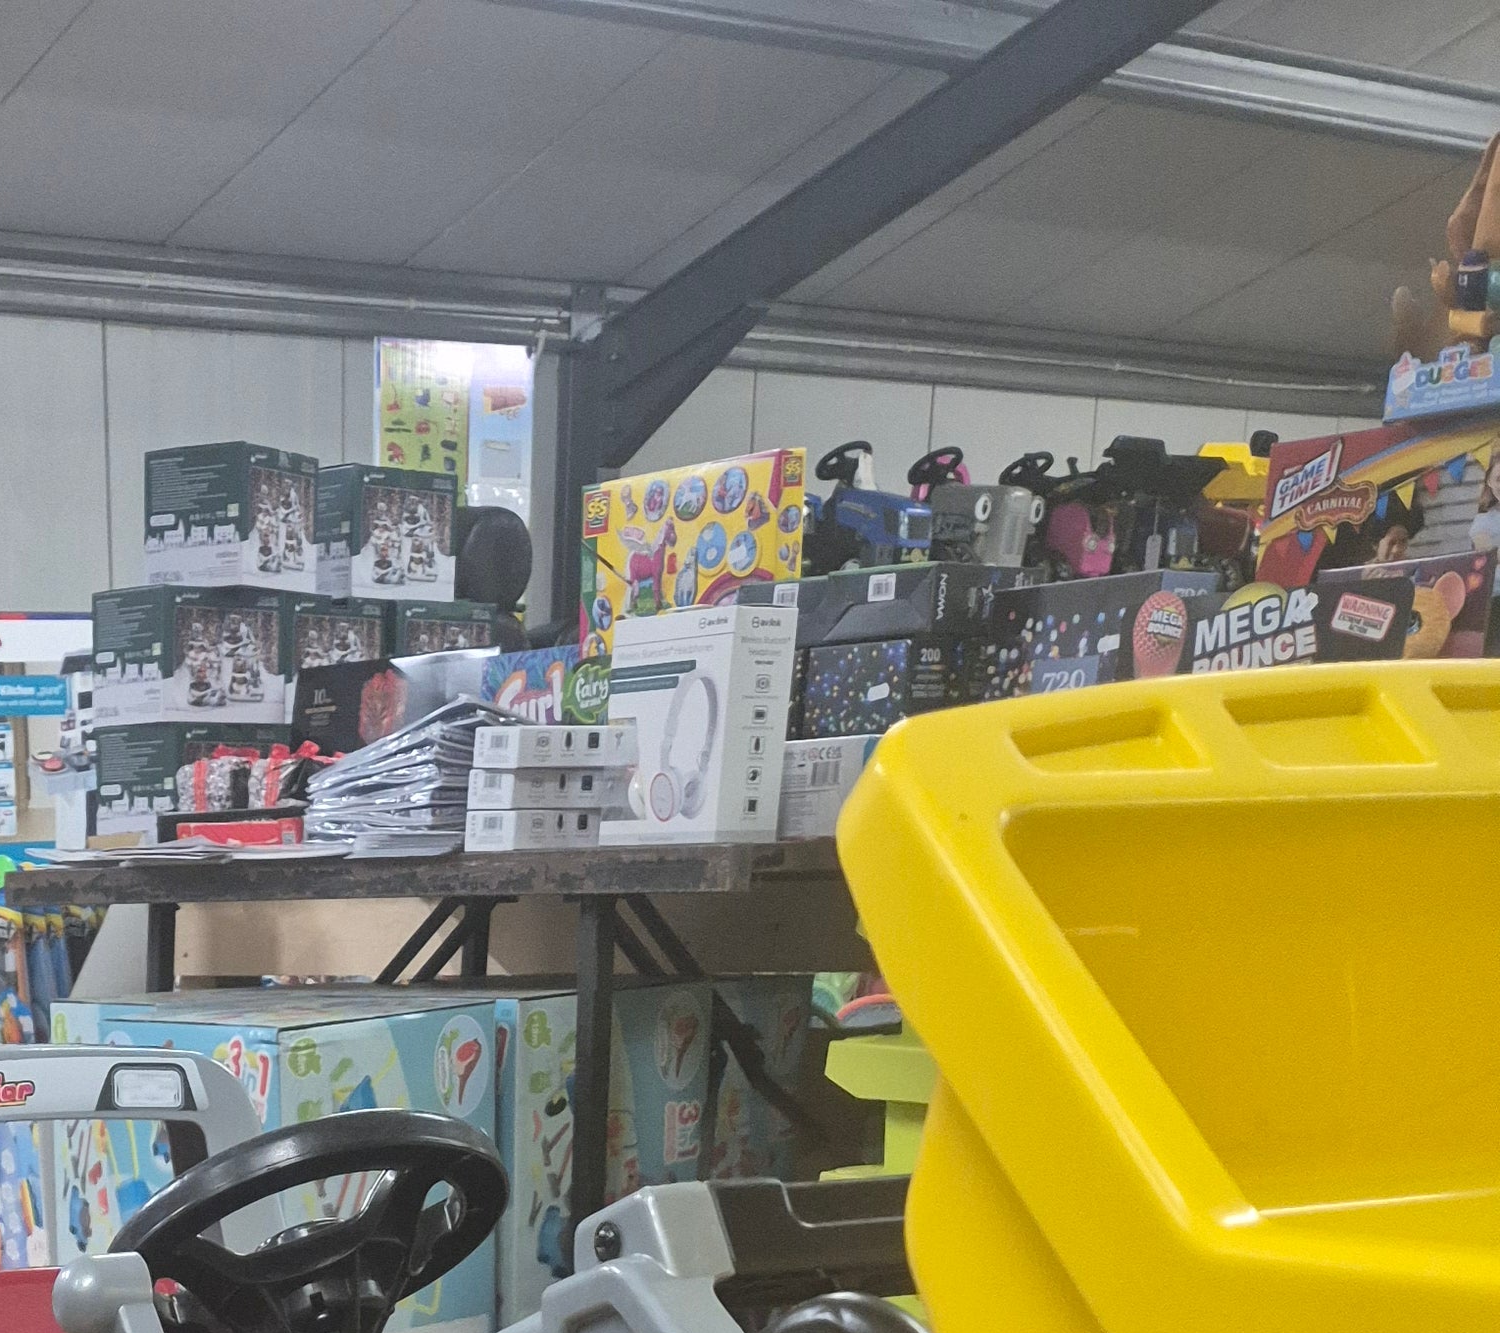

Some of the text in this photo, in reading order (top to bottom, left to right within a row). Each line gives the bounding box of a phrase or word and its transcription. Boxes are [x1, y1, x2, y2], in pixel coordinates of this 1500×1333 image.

[1279, 457, 1327, 495] GAME
[1307, 497, 1363, 515] CARNIVAL
[936, 573, 948, 620] NOMA
[1150, 609, 1183, 628] MEGA
[1194, 588, 1319, 657] MEGA
[920, 648, 941, 662] 200
[575, 674, 610, 704] fairy
[1042, 669, 1086, 694] 720
